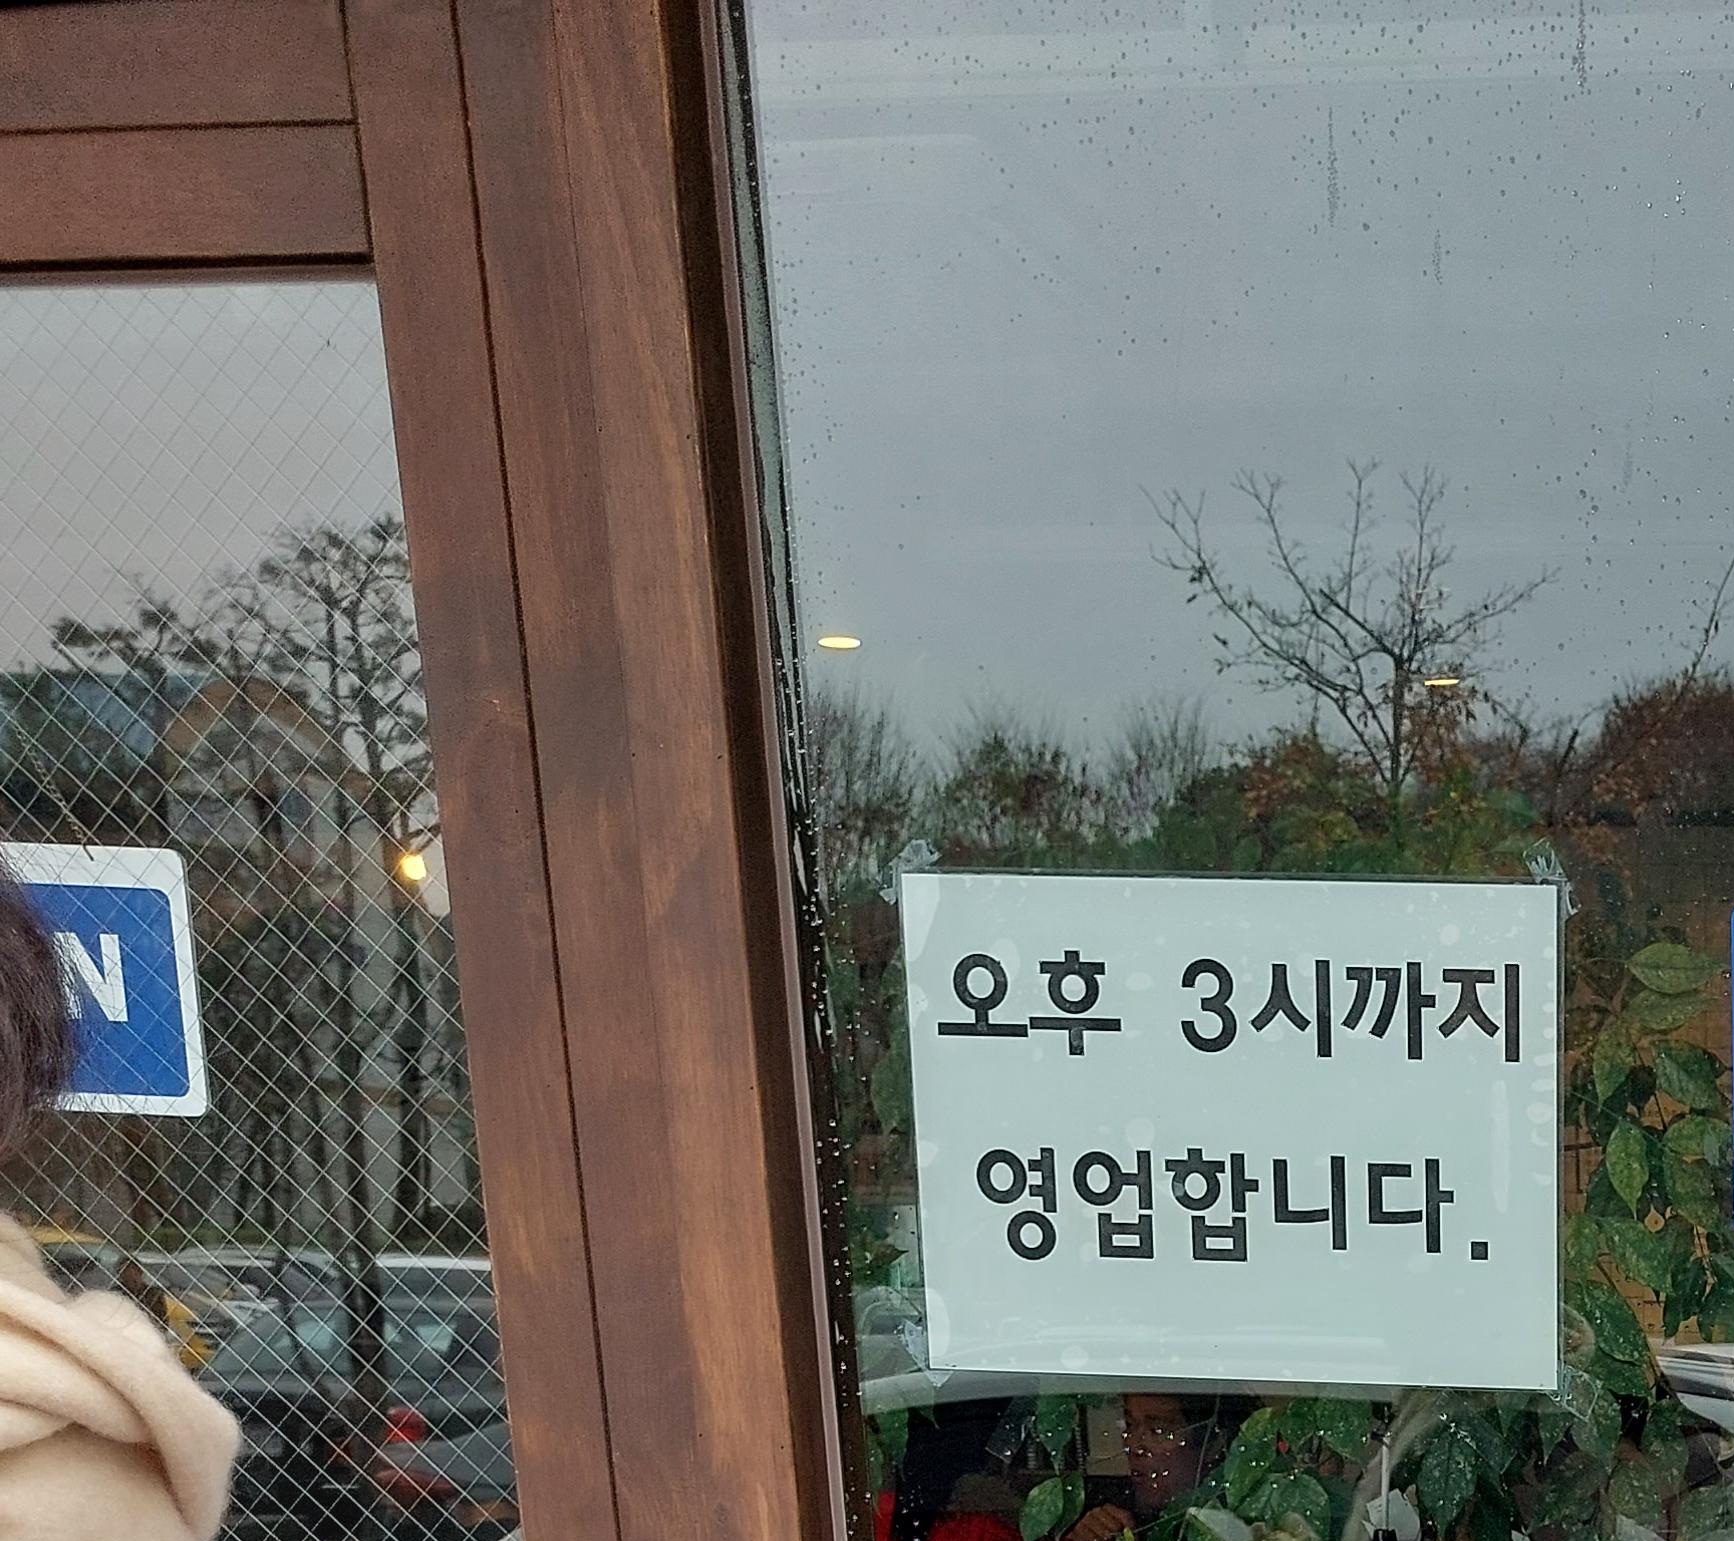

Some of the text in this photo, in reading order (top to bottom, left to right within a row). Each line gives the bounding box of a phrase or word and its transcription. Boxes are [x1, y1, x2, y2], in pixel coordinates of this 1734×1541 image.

[937, 950, 1521, 1063] 오후 3시까지
[976, 1147, 1489, 1262] 영업합니다.
